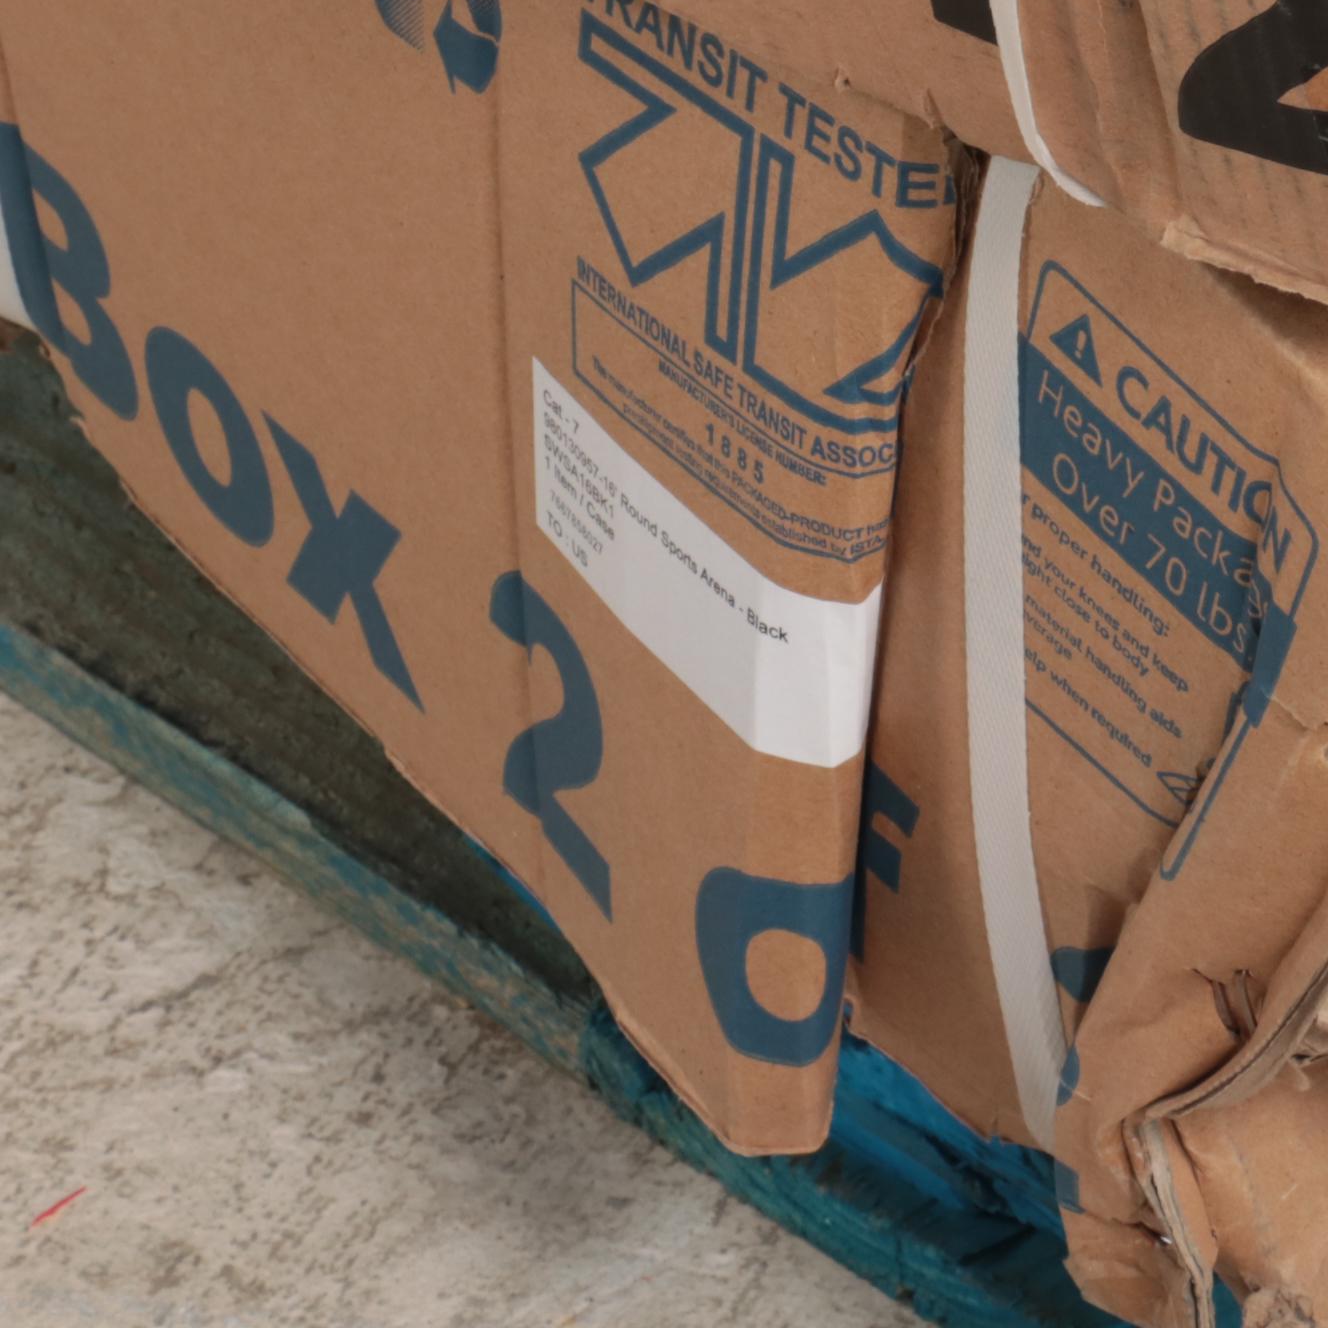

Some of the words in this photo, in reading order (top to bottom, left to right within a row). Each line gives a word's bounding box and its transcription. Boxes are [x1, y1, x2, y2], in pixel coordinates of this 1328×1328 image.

[576, 256, 691, 369] INTERNATIONAL
[693, 350, 734, 400] SAFE
[738, 382, 808, 449] TRANSIT
[1035, 370, 1146, 501] Heavy
[1114, 364, 1292, 576] CAUTION
[0, 121, 425, 715] Box
[487, 568, 613, 924] 2
[545, 510, 563, 539] TO
[571, 538, 588, 568] US
[585, 500, 615, 541] Case
[620, 491, 658, 538] Round
[660, 529, 698, 575] Sports
[700, 566, 735, 607] Arena
[746, 607, 789, 644] Black
[1030, 501, 1088, 560] proper
[1089, 553, 1171, 638] handling:
[1052, 453, 1136, 546] Over
[1146, 532, 1188, 596] 70
[1025, 593, 1082, 653] material
[1085, 647, 1147, 714] handling
[1148, 705, 1183, 740] aids
[1044, 557, 1076, 590] your
[1077, 585, 1120, 630] knees
[1122, 626, 1157, 659] and
[1152, 653, 1189, 693] keep
[1053, 584, 1092, 624] close
[1094, 620, 1110, 640] to
[1111, 632, 1150, 677] body
[1049, 669, 1089, 712] when
[1090, 705, 1153, 769] required
